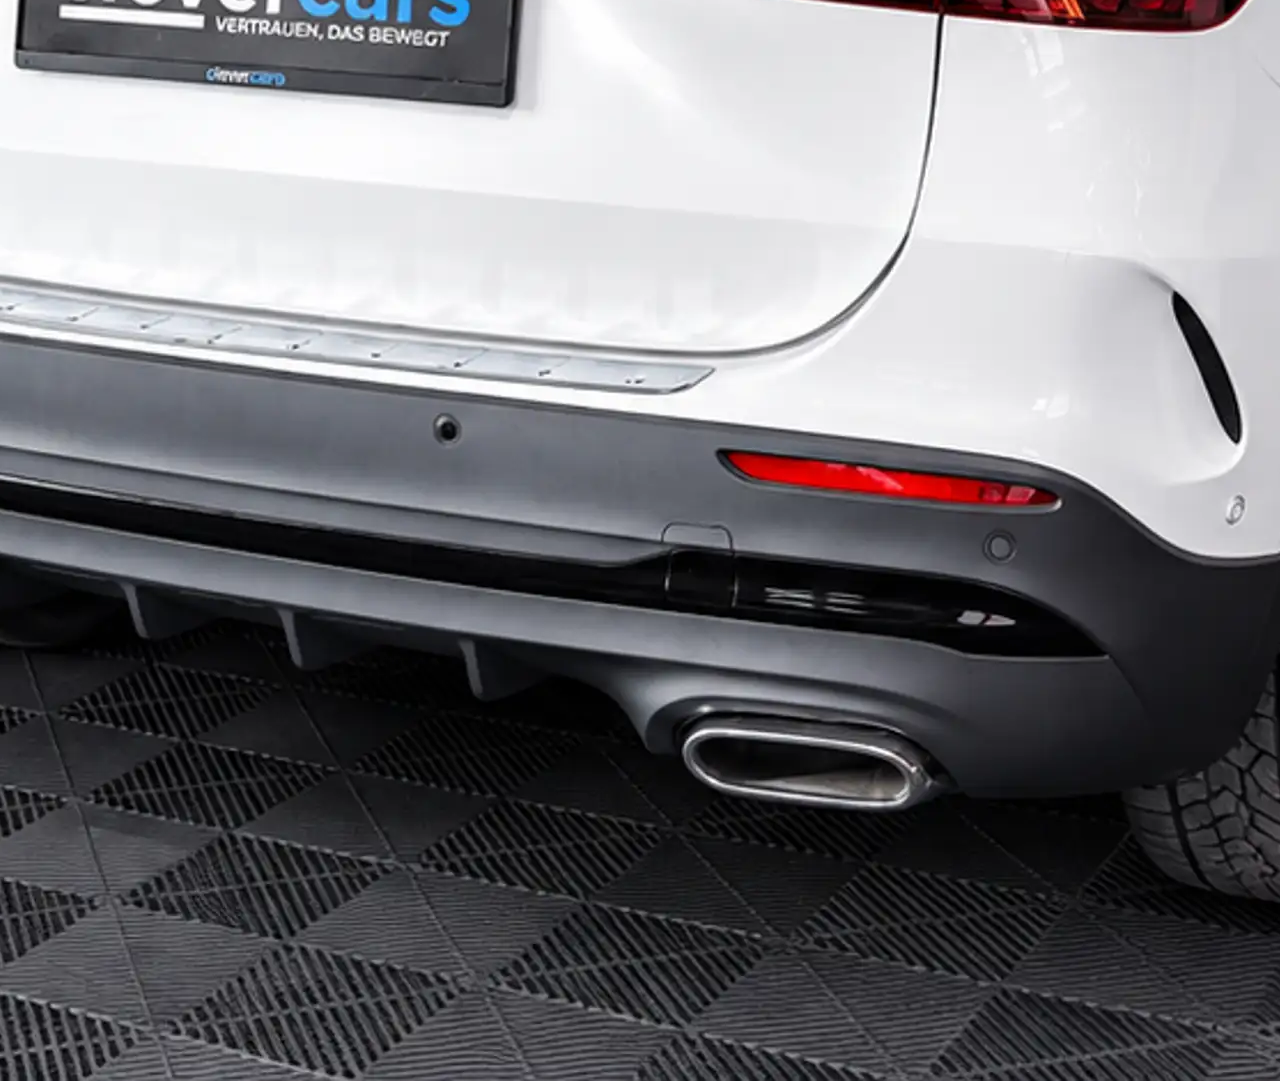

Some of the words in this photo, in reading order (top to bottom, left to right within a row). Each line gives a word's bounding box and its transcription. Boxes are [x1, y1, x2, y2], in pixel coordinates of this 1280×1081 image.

[215, 15, 324, 41] VERTRAUEN,
[327, 23, 365, 43] DAS
[368, 26, 451, 47] BEWEGT
